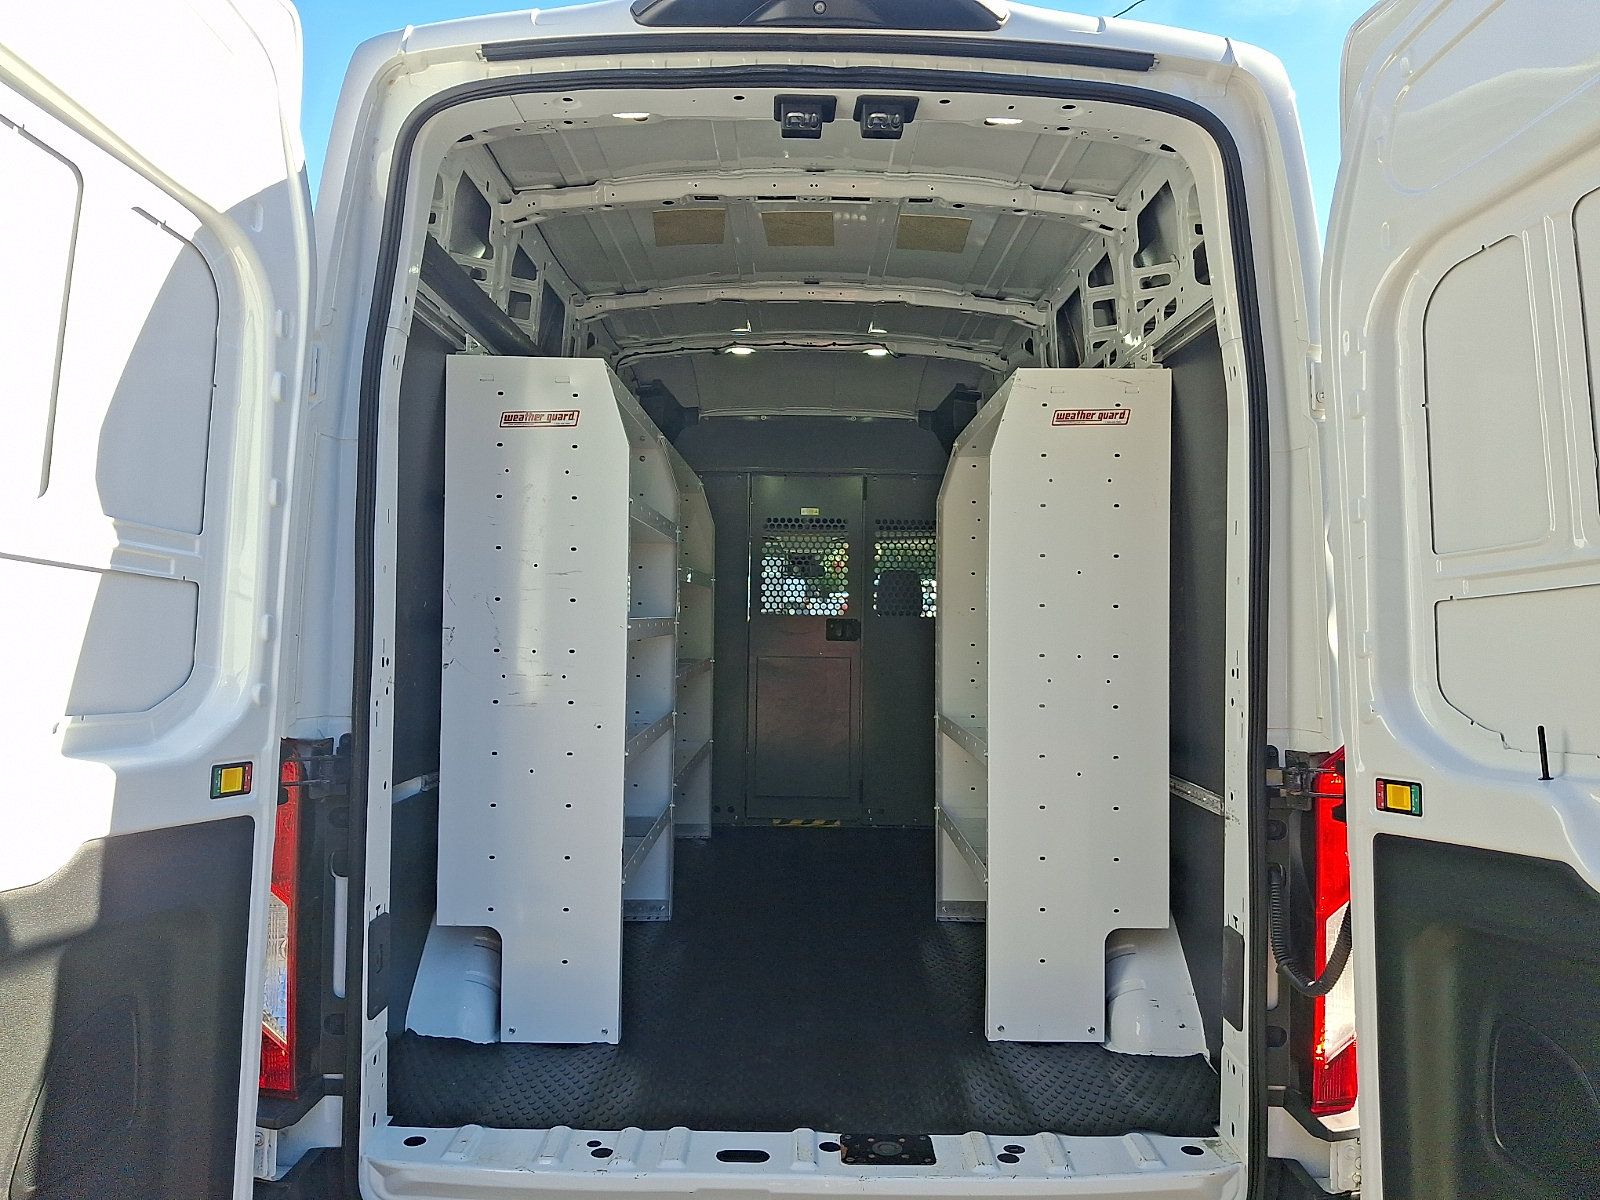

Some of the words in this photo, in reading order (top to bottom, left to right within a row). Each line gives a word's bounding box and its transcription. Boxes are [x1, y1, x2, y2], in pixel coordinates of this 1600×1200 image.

[504, 412, 545, 422] weather
[546, 412, 575, 423] guard
[1056, 410, 1096, 420] weather
[1097, 410, 1126, 421] guard
